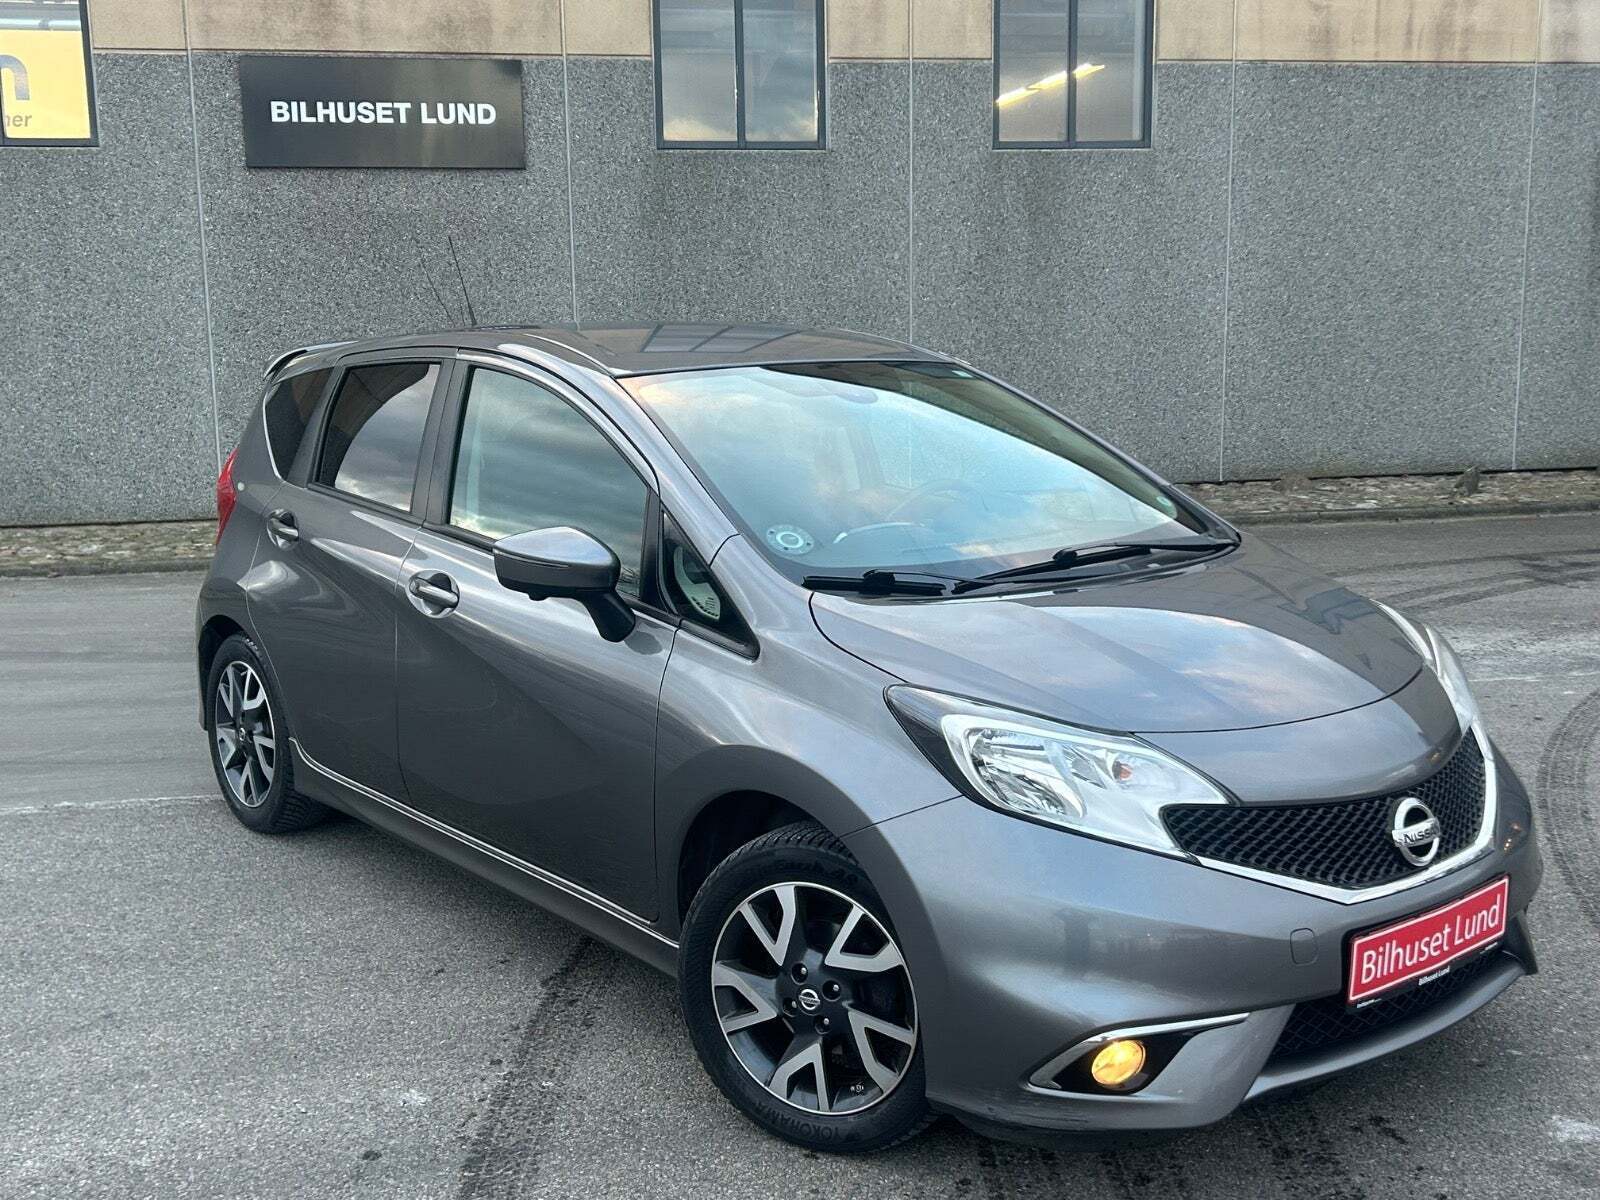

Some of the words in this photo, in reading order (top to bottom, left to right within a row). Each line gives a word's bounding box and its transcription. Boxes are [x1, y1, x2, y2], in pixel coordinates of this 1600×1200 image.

[270, 101, 411, 123] BILHUSET
[420, 103, 497, 125] LUND
[1403, 825, 1438, 844] NISS
[1360, 923, 1451, 985] Bilhuset
[1454, 893, 1501, 946] Lund
